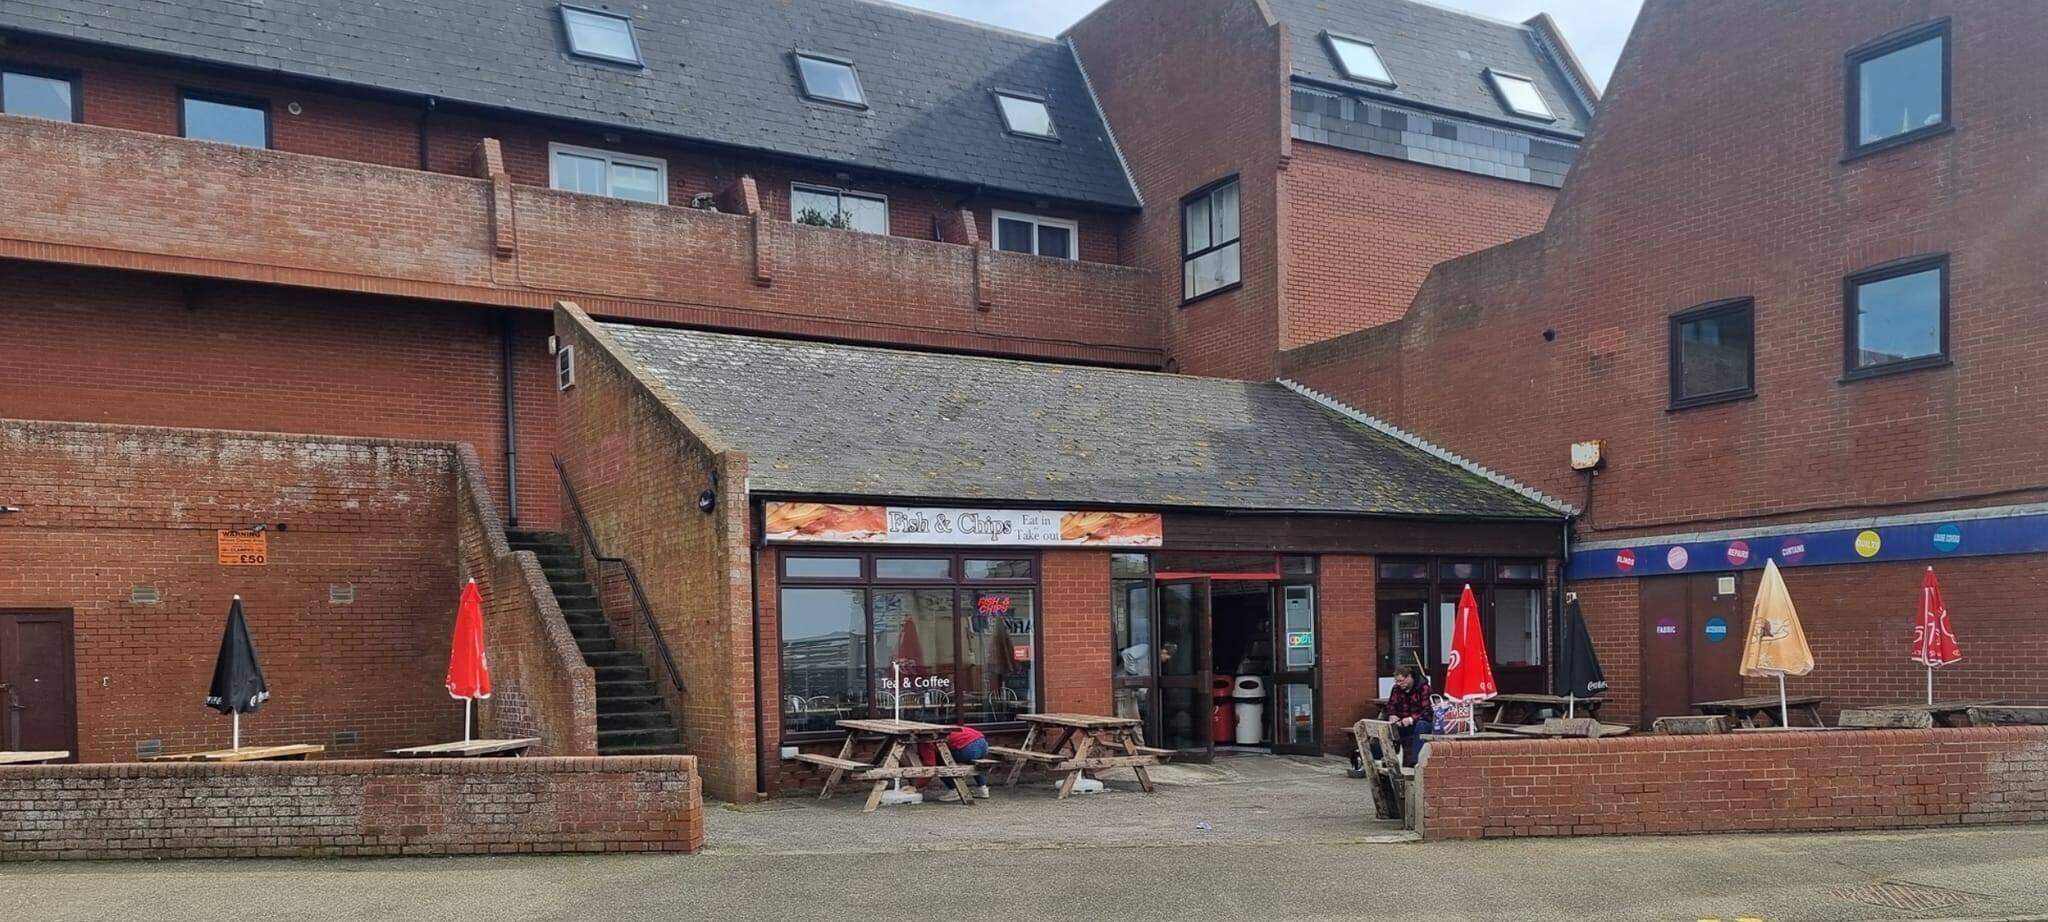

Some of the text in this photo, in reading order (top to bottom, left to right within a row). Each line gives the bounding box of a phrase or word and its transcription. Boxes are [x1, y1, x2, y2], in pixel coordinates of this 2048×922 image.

[889, 511, 1012, 541] Fish & Chips
[1022, 514, 1051, 526] Eat in
[1016, 528, 1061, 541] Take out
[240, 554, 264, 563] £50
[978, 597, 999, 606] FISH
[980, 604, 1009, 614] CHIPS
[881, 675, 950, 689] Tea & Coffee
